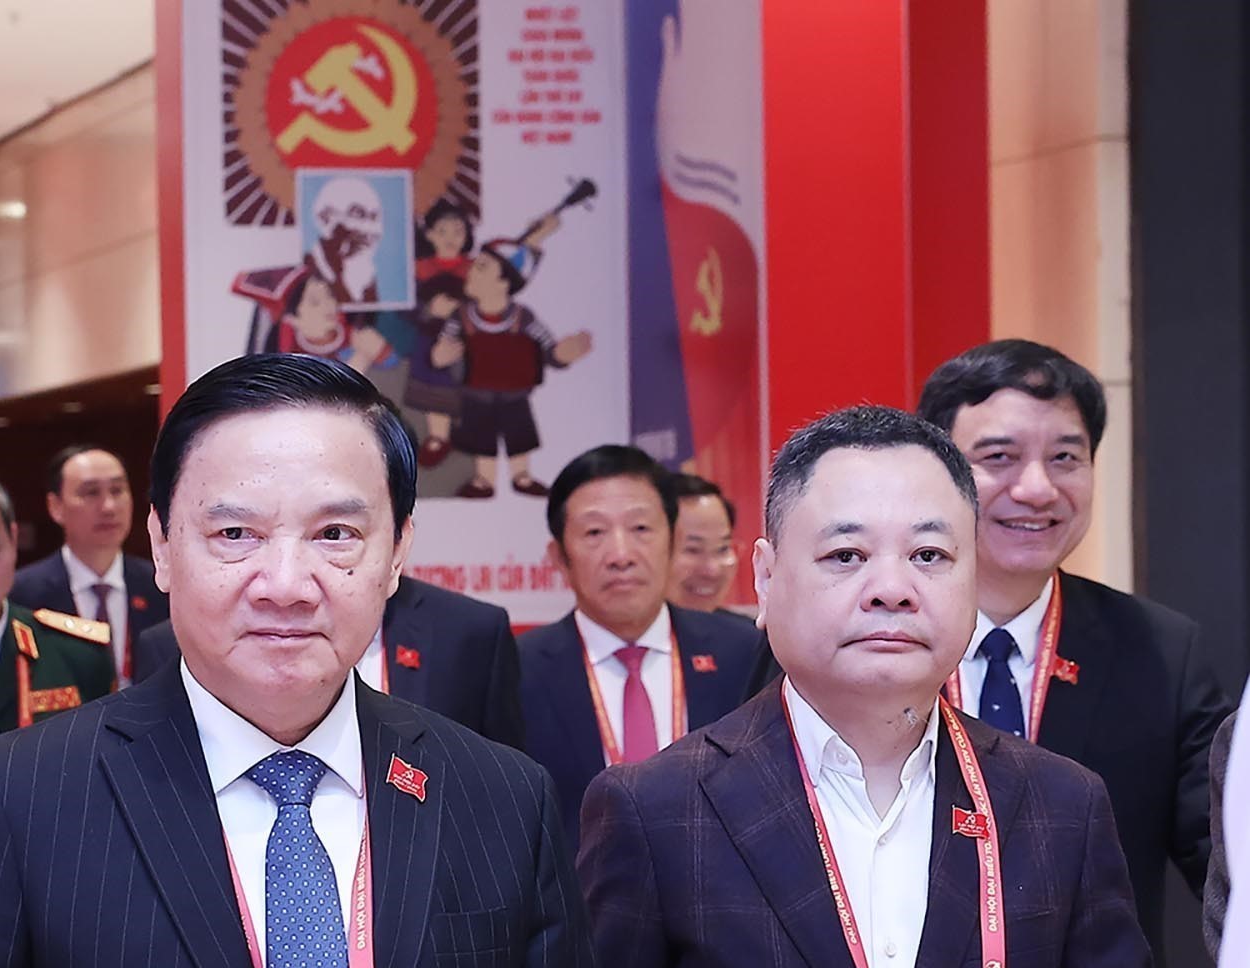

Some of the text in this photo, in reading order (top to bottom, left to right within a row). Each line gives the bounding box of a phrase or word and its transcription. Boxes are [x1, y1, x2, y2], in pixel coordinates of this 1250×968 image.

[987, 877, 998, 895] ĐẠI
[357, 891, 367, 911] ĐẠI
[986, 895, 998, 914] HỘI
[357, 911, 367, 931] HỘI
[987, 914, 998, 932] ĐẠI
[357, 931, 367, 950] ĐẠI
